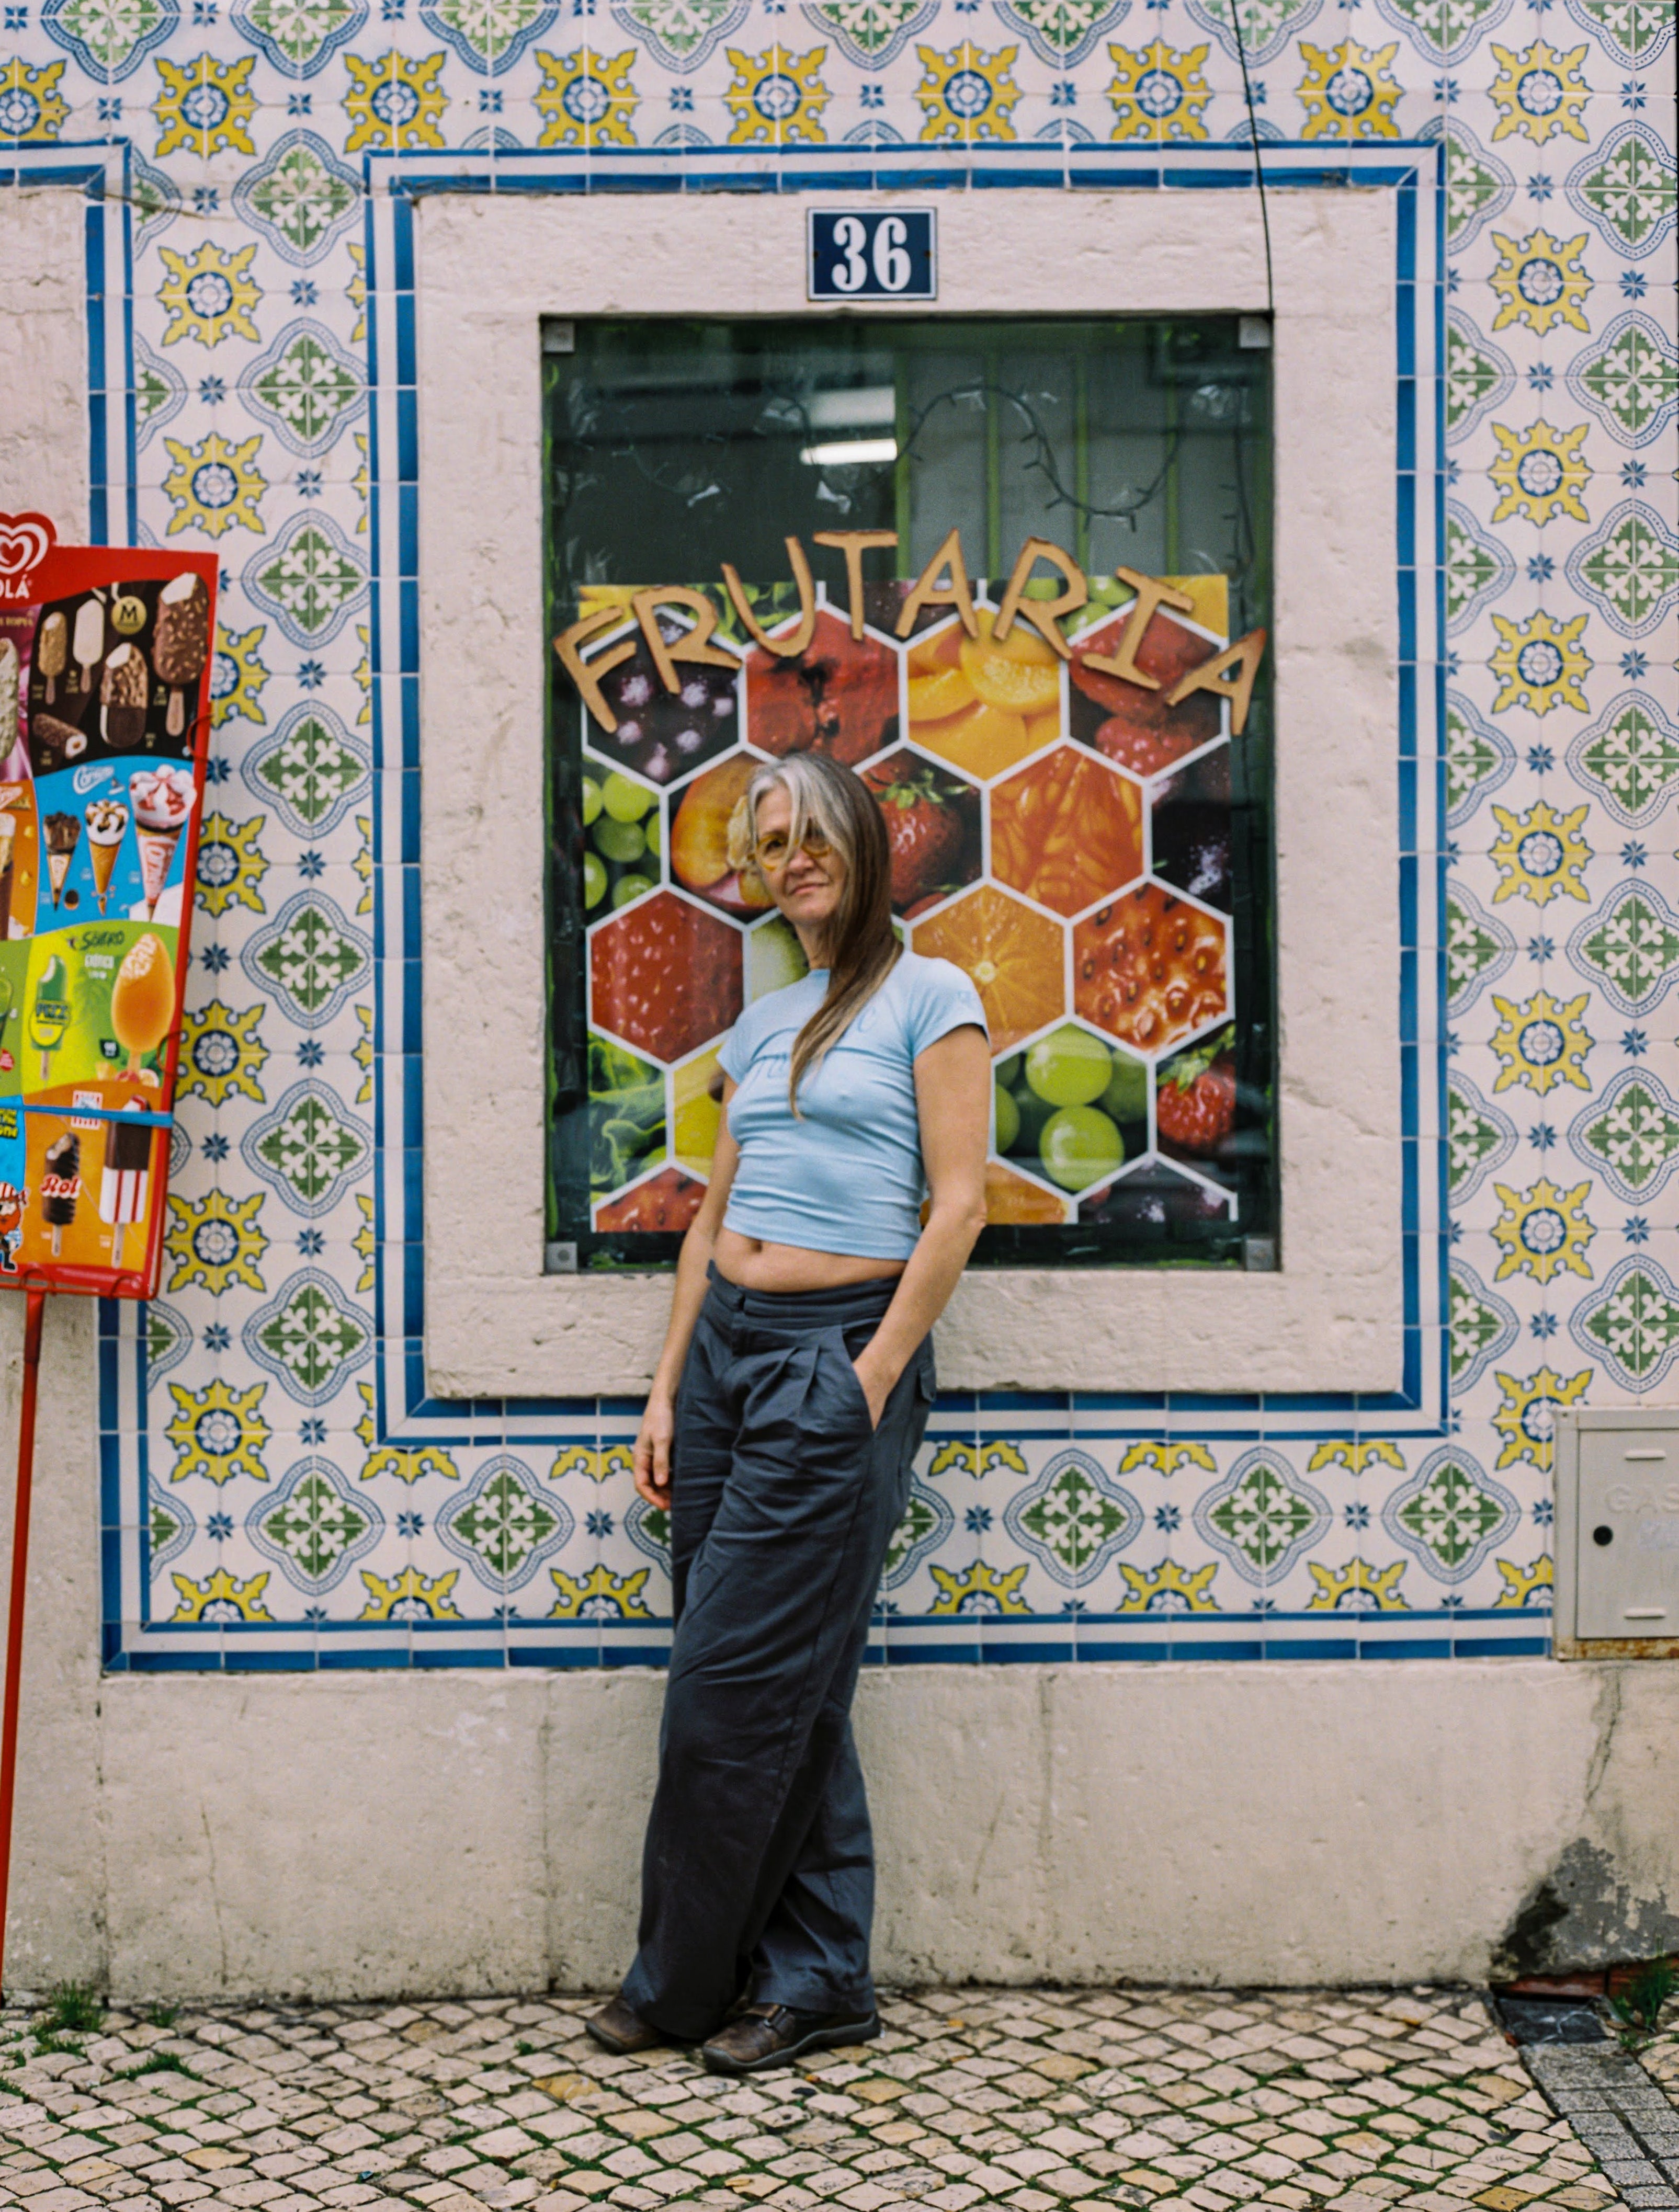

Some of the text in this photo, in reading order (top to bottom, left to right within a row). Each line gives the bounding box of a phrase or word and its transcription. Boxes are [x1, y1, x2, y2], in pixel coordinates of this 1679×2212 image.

[832, 216, 912, 292] 36
[553, 527, 1266, 734] FRUTARIA
[41, 1176, 80, 1195] Rol
